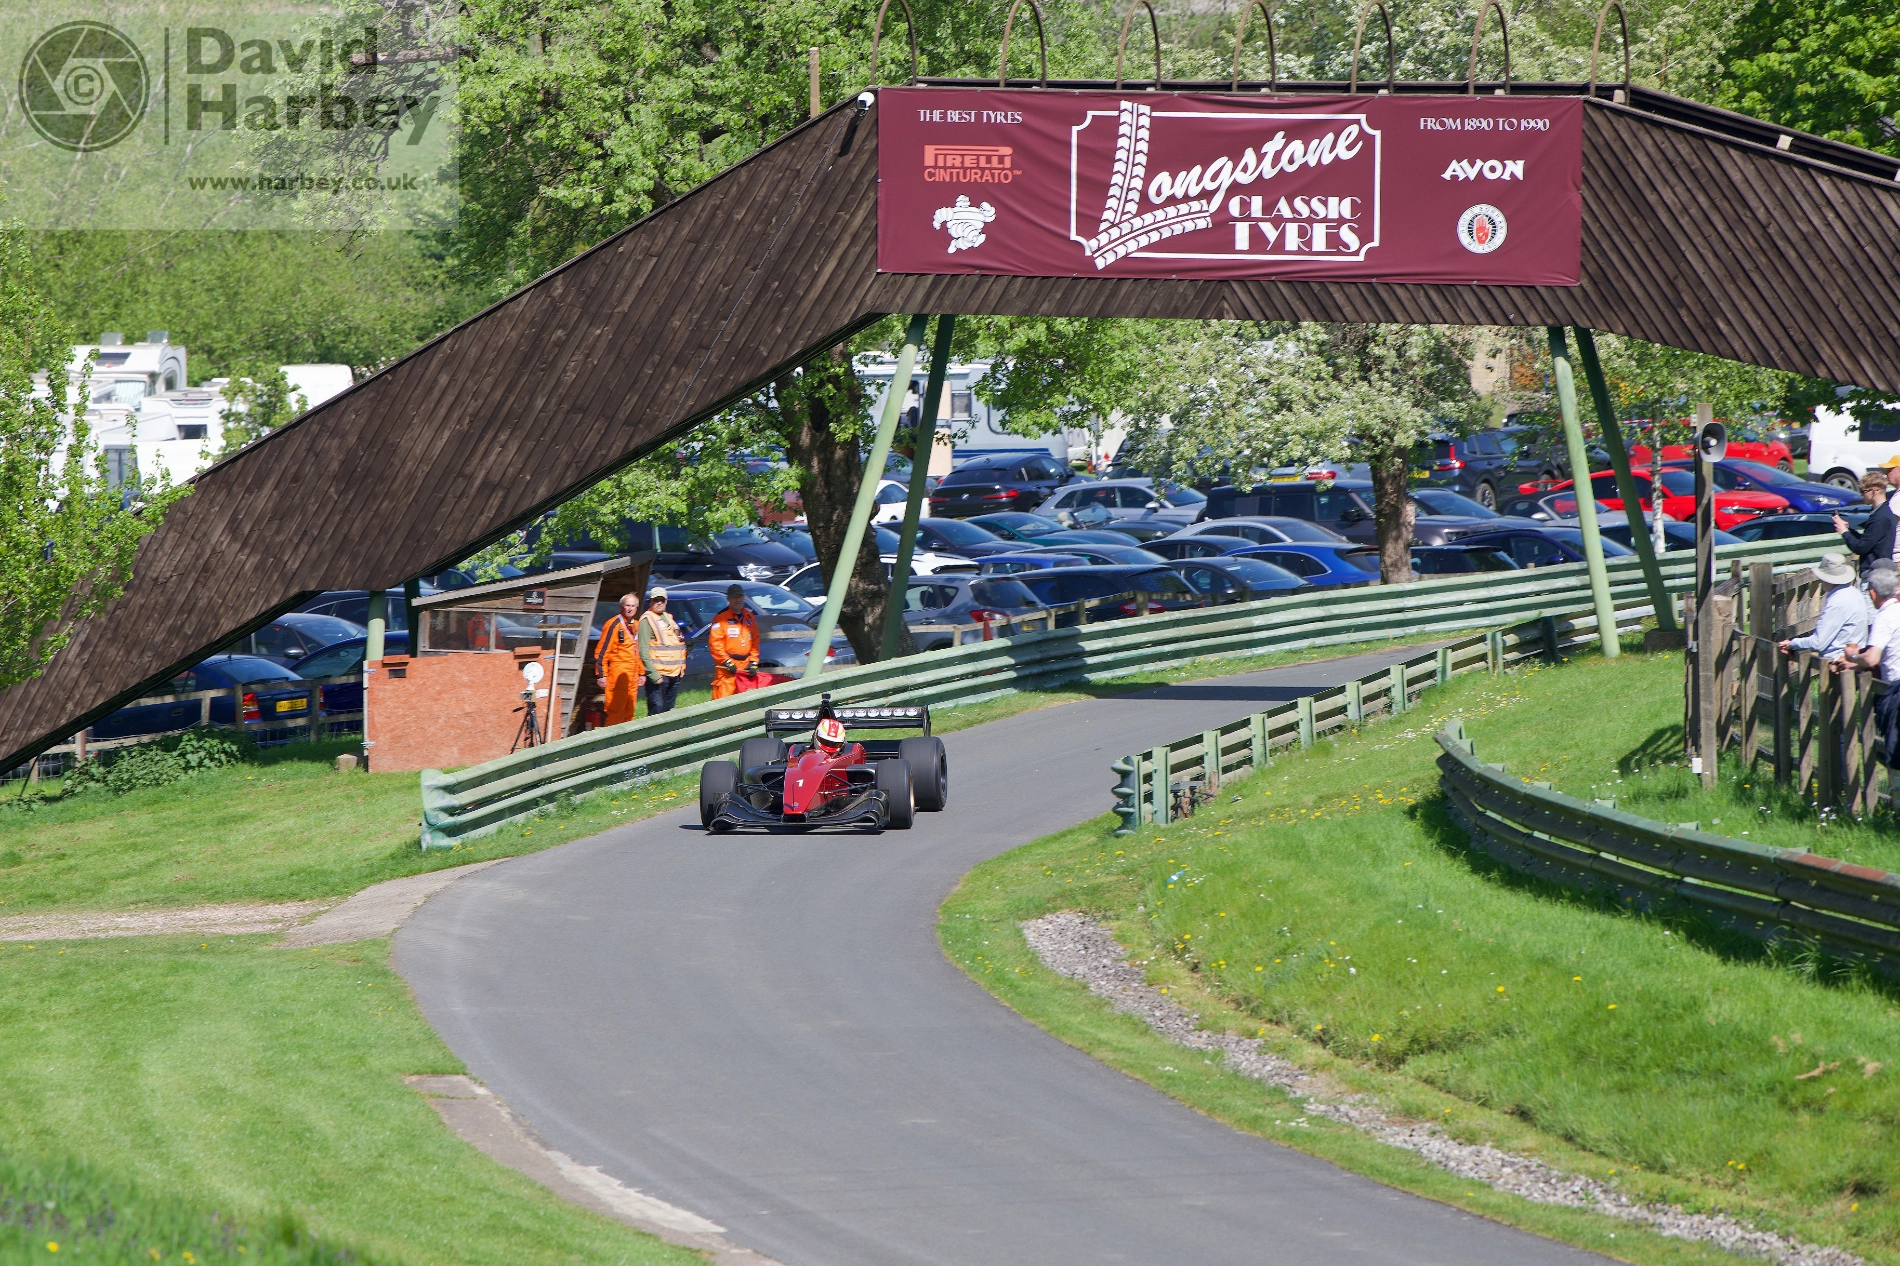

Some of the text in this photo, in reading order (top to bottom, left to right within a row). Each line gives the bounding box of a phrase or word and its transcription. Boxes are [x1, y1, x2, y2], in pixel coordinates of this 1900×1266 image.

[917, 109, 1023, 124] THE BEST TYRES
[1420, 117, 1550, 132] FROM 1890 TO 1990
[924, 145, 1013, 168] PIRELLI
[924, 168, 1013, 184] CINTURATO
[1441, 159, 1526, 181] AVON
[1228, 195, 1362, 219] CLASSIC
[1229, 221, 1361, 252] TYRES
